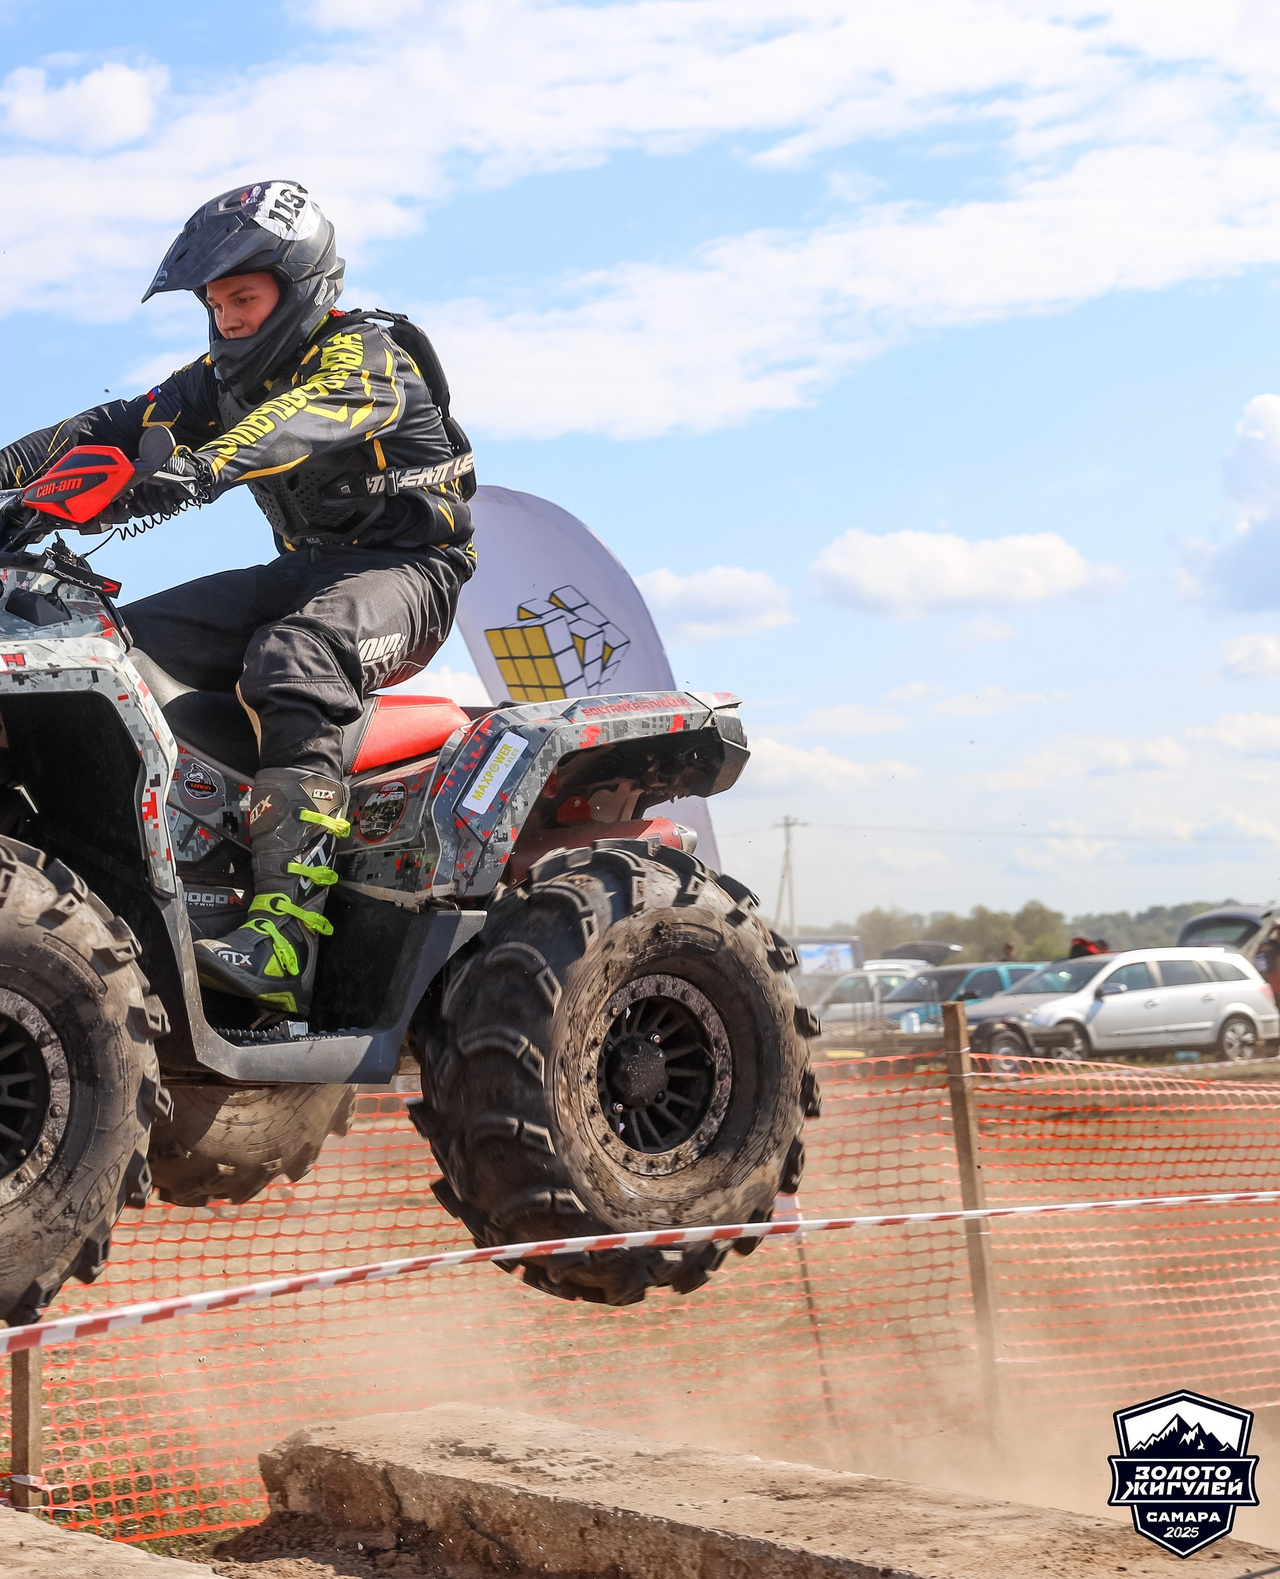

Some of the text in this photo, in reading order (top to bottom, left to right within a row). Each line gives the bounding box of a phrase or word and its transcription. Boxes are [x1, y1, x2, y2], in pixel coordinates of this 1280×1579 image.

[36, 477, 84, 498] can-am
[504, 748, 520, 768] AXLES
[472, 743, 513, 801] MAXPOWER
[312, 789, 336, 801] GTX
[250, 794, 273, 825] GTX
[217, 950, 253, 967] GTX
